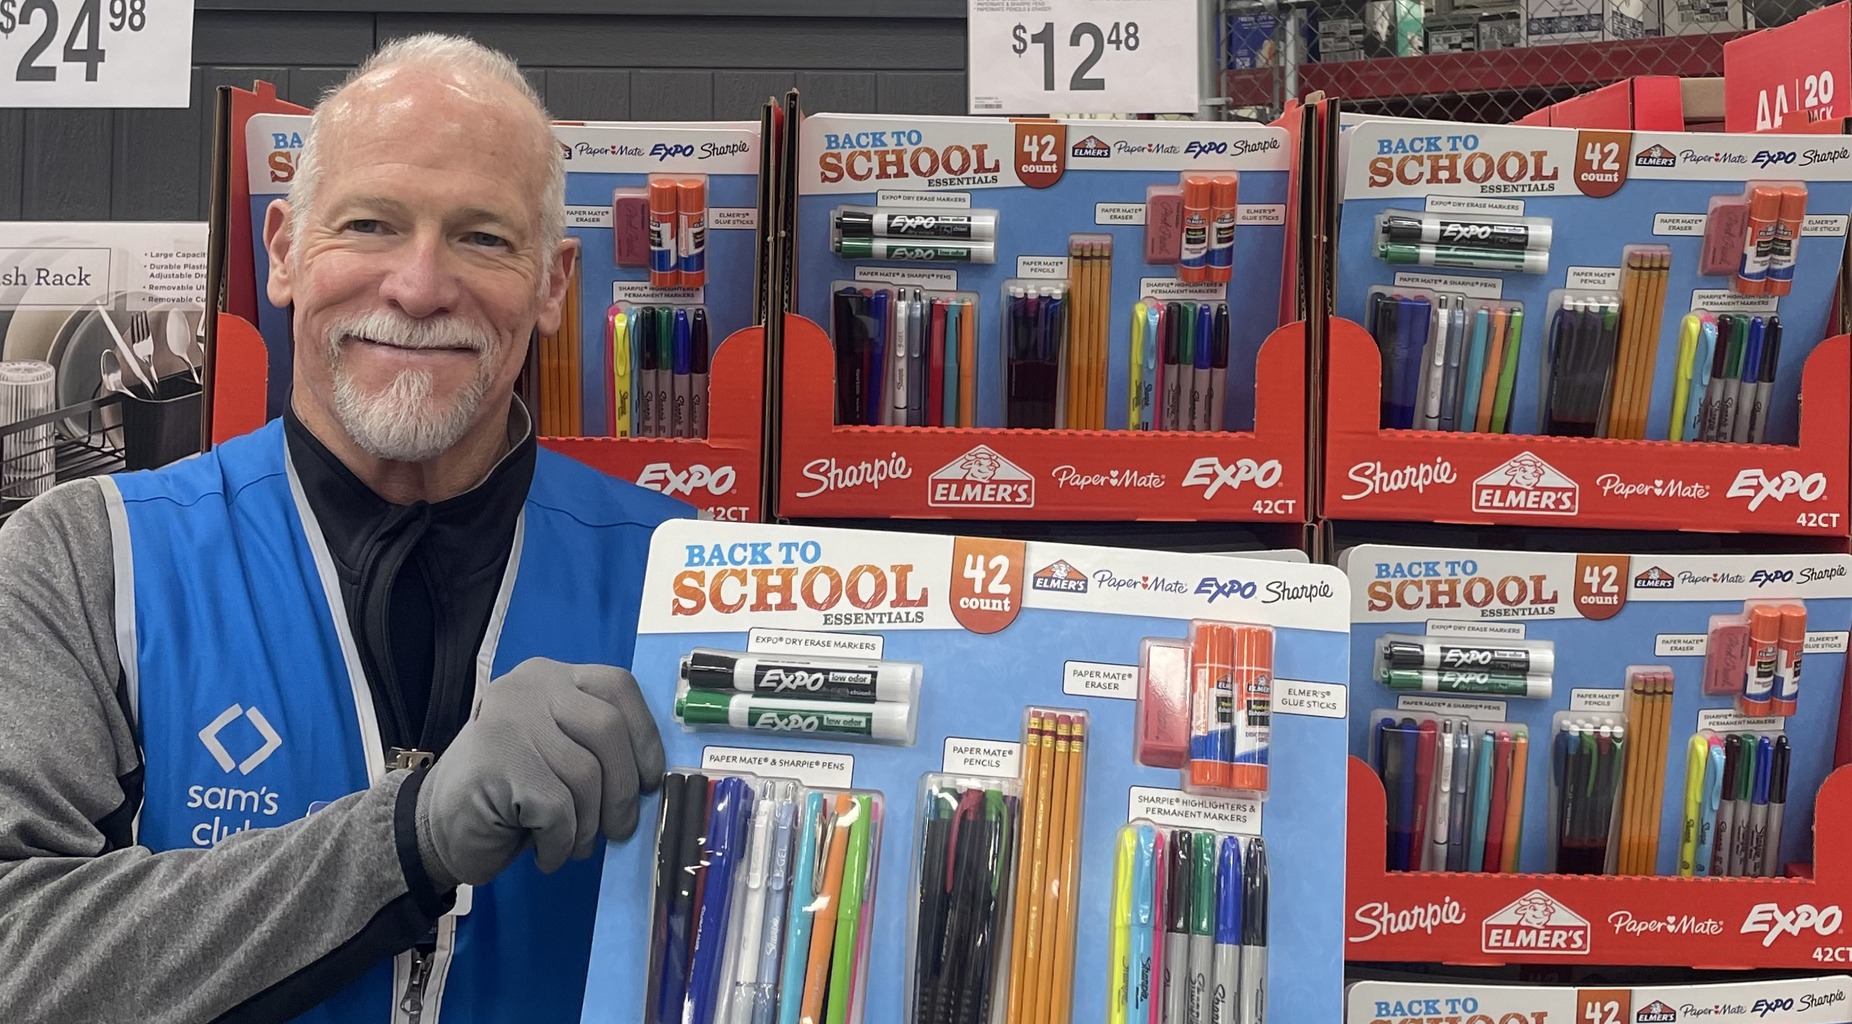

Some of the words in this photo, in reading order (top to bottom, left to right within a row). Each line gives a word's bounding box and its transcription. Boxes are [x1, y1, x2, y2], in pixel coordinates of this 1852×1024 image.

[1805, 71, 1833, 109] 20
[575, 142, 610, 156] Paper
[616, 145, 644, 156] Mate
[649, 144, 694, 161] EXPO
[698, 141, 749, 159] Sharpie
[825, 132, 886, 151] BACK
[891, 130, 923, 149] TO
[1024, 135, 1057, 164] 42
[1073, 147, 1110, 159] ELMER'S
[1114, 141, 1147, 154] Paper
[1152, 144, 1179, 154] Mate
[1184, 141, 1227, 159] EXPO
[1231, 138, 1280, 156] Sharpie
[819, 143, 1000, 184] SCHOOL
[1022, 161, 1057, 174] count
[1635, 155, 1676, 167] ELMER'S
[1680, 150, 1715, 164] Paper
[1720, 153, 1747, 163] Mate
[1752, 151, 1796, 169] EXPO
[1799, 148, 1850, 166] Sharpie
[926, 174, 999, 188] ESSENTIALS
[150, 251, 174, 260] Large
[175, 251, 207, 260] Capacit
[0, 265, 28, 287] sh
[35, 267, 91, 285] Rack
[148, 271, 193, 280] Adjustable
[635, 463, 736, 496] EXPO
[796, 452, 912, 497] Sharpie
[1052, 465, 1109, 490] Paper
[1115, 469, 1165, 488] Mate
[1182, 457, 1282, 500] EXPO
[1342, 457, 1457, 500] Sharpie
[933, 480, 1031, 506] ELMER'S
[1596, 474, 1656, 498] Paper
[1660, 479, 1709, 498] Mate
[1726, 469, 1827, 511] EXPO
[1253, 500, 1296, 514] 42CT
[1477, 486, 1576, 511] ELMER'S
[1797, 513, 1840, 527] 42CT
[685, 542, 772, 567] BACK
[779, 541, 821, 564] TO
[964, 554, 1011, 596] 42
[1375, 561, 1441, 579] BACK
[1445, 560, 1477, 576] TO
[1584, 566, 1618, 593] 42
[672, 562, 928, 618] SCHOOL
[1034, 576, 1087, 593] ELMER'S
[1093, 570, 1141, 590] Paper
[1147, 577, 1187, 593] Mate
[1194, 577, 1256, 603] EXPO
[1262, 581, 1333, 603] Sharpie
[1368, 573, 1558, 613] SCHOOL
[960, 597, 1010, 611] count
[1581, 591, 1618, 605] count
[821, 610, 924, 625] ESSENTIALS
[1478, 605, 1557, 619] ESSENTIALS
[785, 638, 803, 646] DRY
[805, 639, 831, 647] ERASE
[834, 641, 875, 650] MARKERS
[758, 668, 825, 692] EXPO
[830, 672, 845, 683] low
[846, 673, 869, 684] odor
[1073, 670, 1101, 678] PAPER
[1085, 681, 1119, 690] ERASER
[1282, 698, 1304, 707] GLUE
[1307, 701, 1336, 710] STICKS
[753, 711, 820, 732] EXPO
[825, 717, 841, 726] low
[842, 718, 863, 728] odor
[953, 746, 981, 755] PAPER
[710, 755, 737, 763] PAPER
[822, 762, 844, 770] PENS
[964, 758, 1000, 767] PENCILS
[187, 786, 278, 814] sam's
[1181, 798, 1247, 813] HIGHLIGHTERS
[1145, 806, 1201, 821] PERMANENT
[1204, 811, 1247, 823] MARKERS
[192, 816, 250, 847] cl
[1349, 896, 1465, 942] Sharpie
[1740, 903, 1845, 949] EXPO
[1486, 927, 1587, 951] ELMER'S
[1637, 1011, 1676, 1023] ELMER'S
[1680, 1004, 1715, 1017] Paper
[1719, 1004, 1746, 1015] Mate
[1751, 998, 1793, 1017] EXPO
[1797, 990, 1845, 1012] Sharpie
